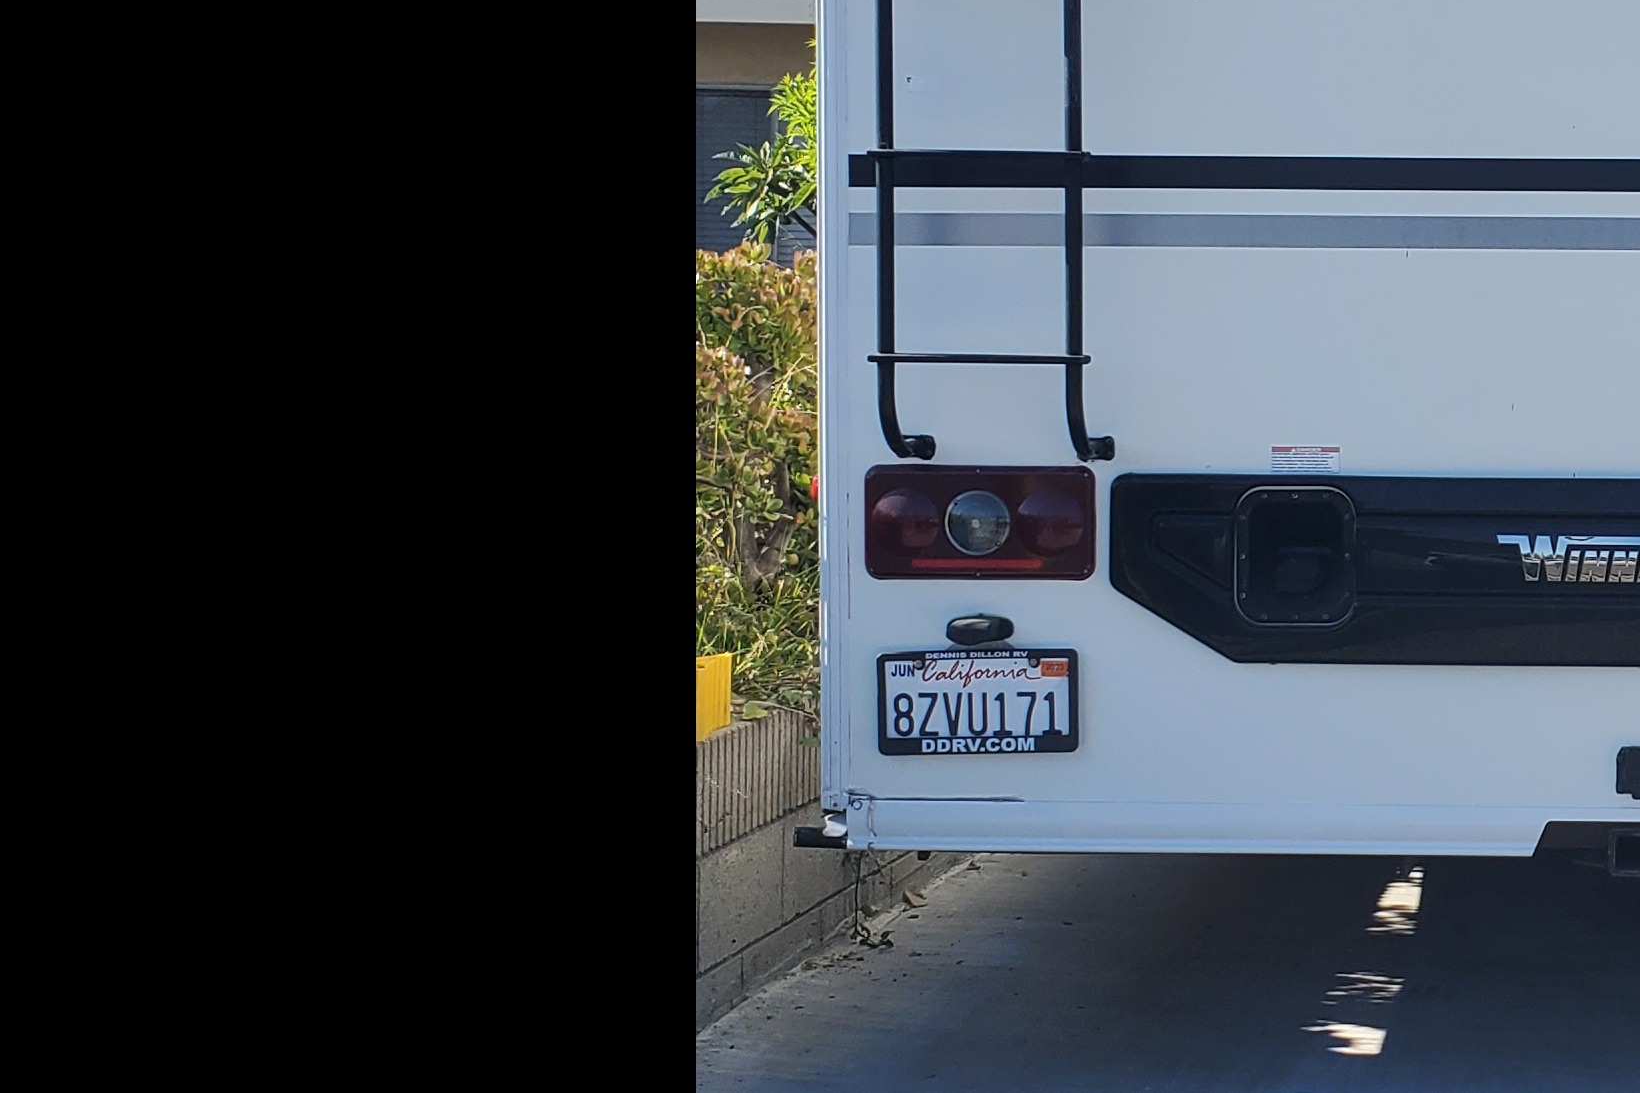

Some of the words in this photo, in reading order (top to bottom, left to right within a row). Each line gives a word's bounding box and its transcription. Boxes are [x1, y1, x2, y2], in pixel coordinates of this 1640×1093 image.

[890, 664, 915, 677] JUN
[921, 659, 1041, 688] California
[893, 691, 1063, 737] 8ZVU171
[921, 737, 1036, 753] DDRV.COM
